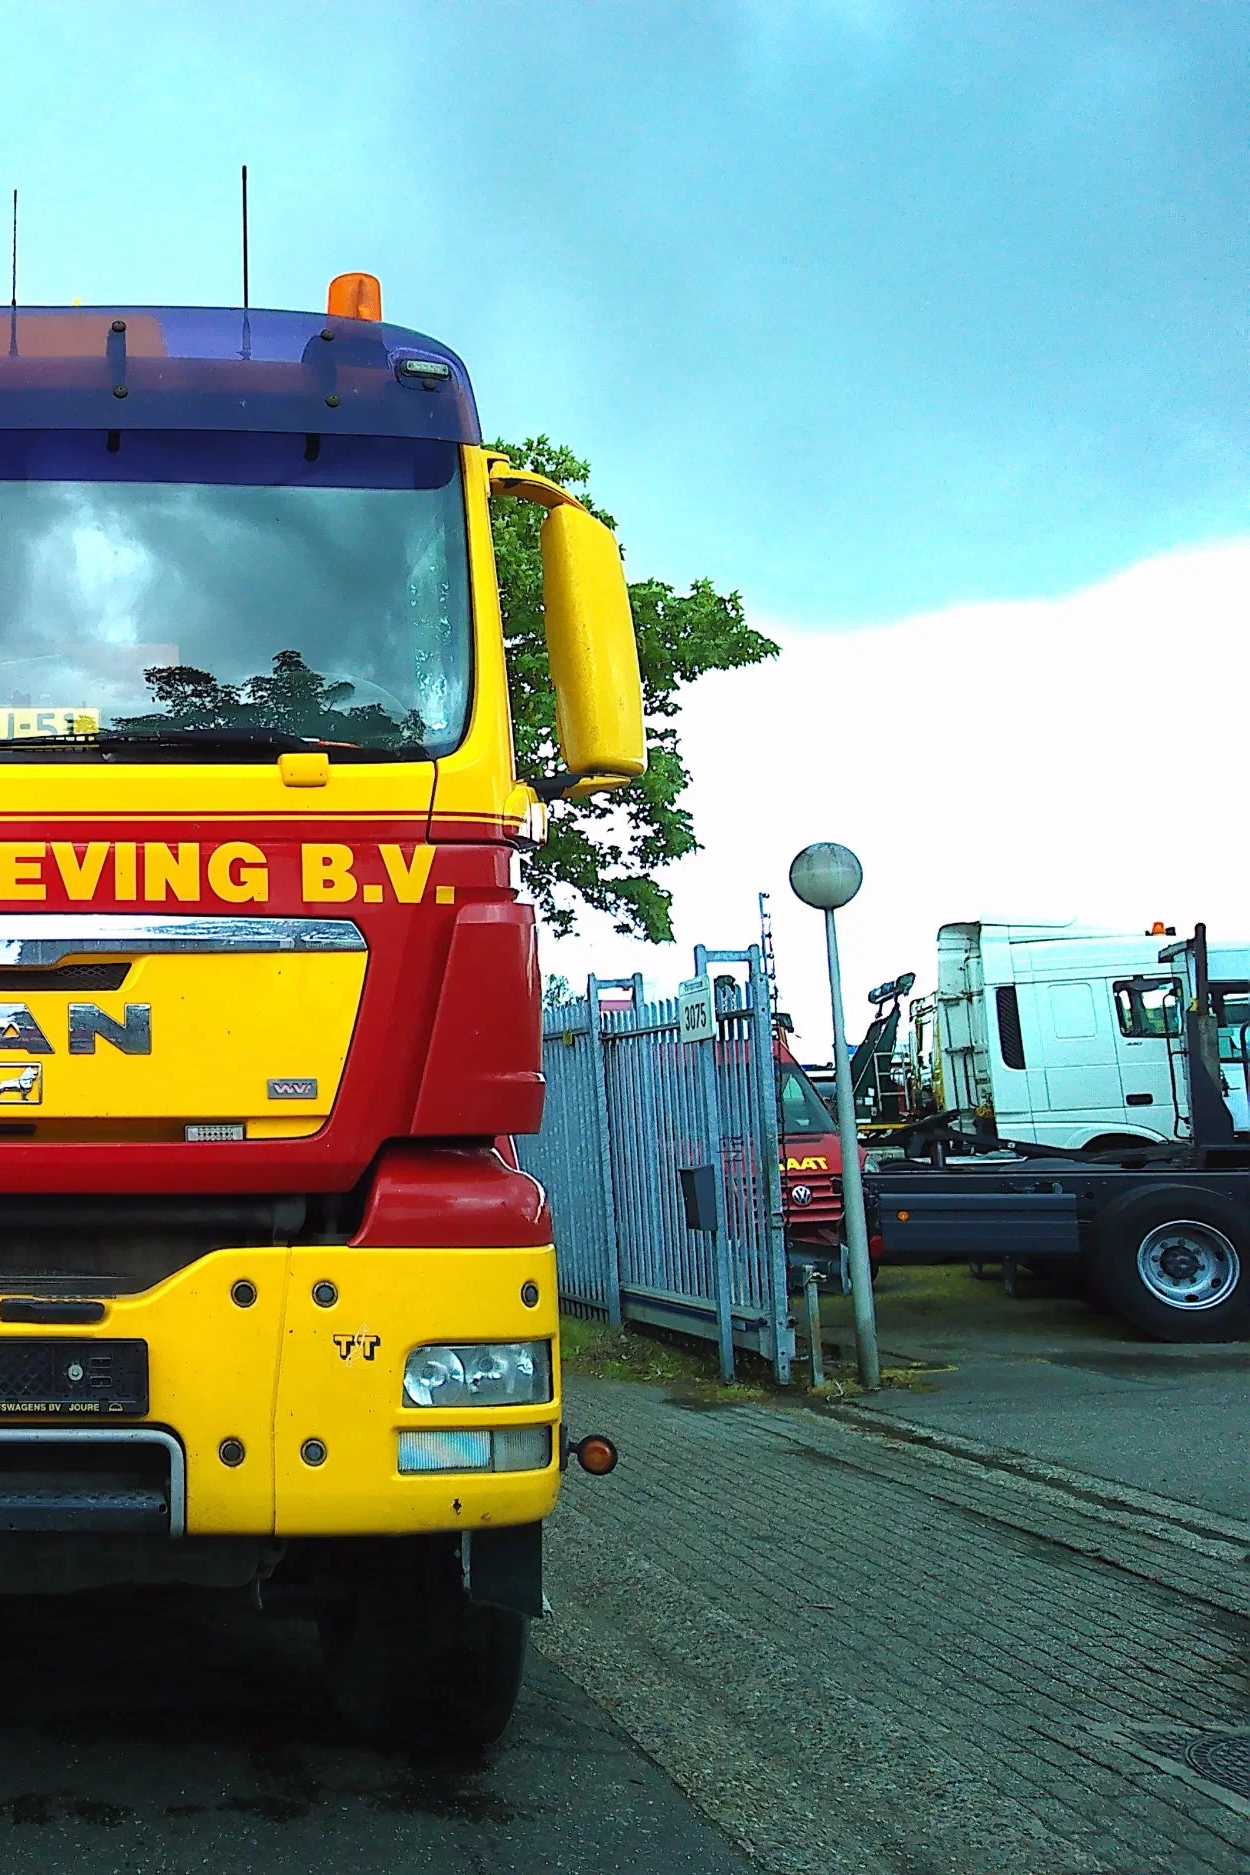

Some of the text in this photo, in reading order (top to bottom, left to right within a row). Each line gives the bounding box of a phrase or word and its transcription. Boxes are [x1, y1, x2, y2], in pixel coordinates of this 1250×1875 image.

[301, 843, 456, 905] B.V.
[684, 1002, 707, 1032] 3075
[48, 1402, 62, 1412] BV
[68, 1402, 100, 1412] JOURE
